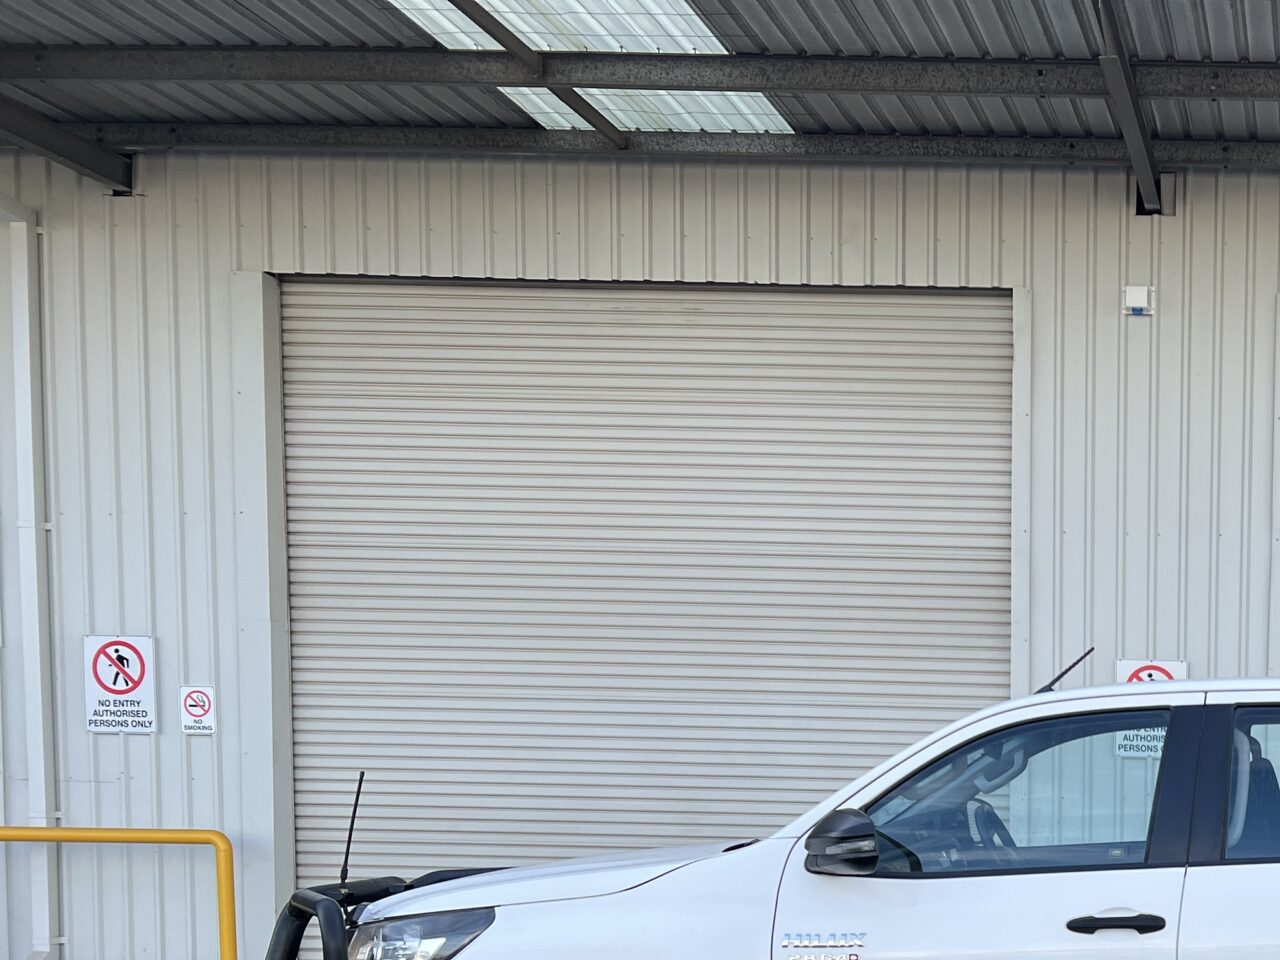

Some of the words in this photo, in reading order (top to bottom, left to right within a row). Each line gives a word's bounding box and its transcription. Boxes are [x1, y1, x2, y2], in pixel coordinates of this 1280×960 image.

[92, 710, 148, 718] AUTHORISED
[88, 720, 129, 728] PERSONS
[131, 720, 153, 728] ONLY
[1123, 734, 1166, 743] AUTHORIS
[1118, 744, 1158, 752] PERSONS
[782, 933, 867, 948] HILUX
